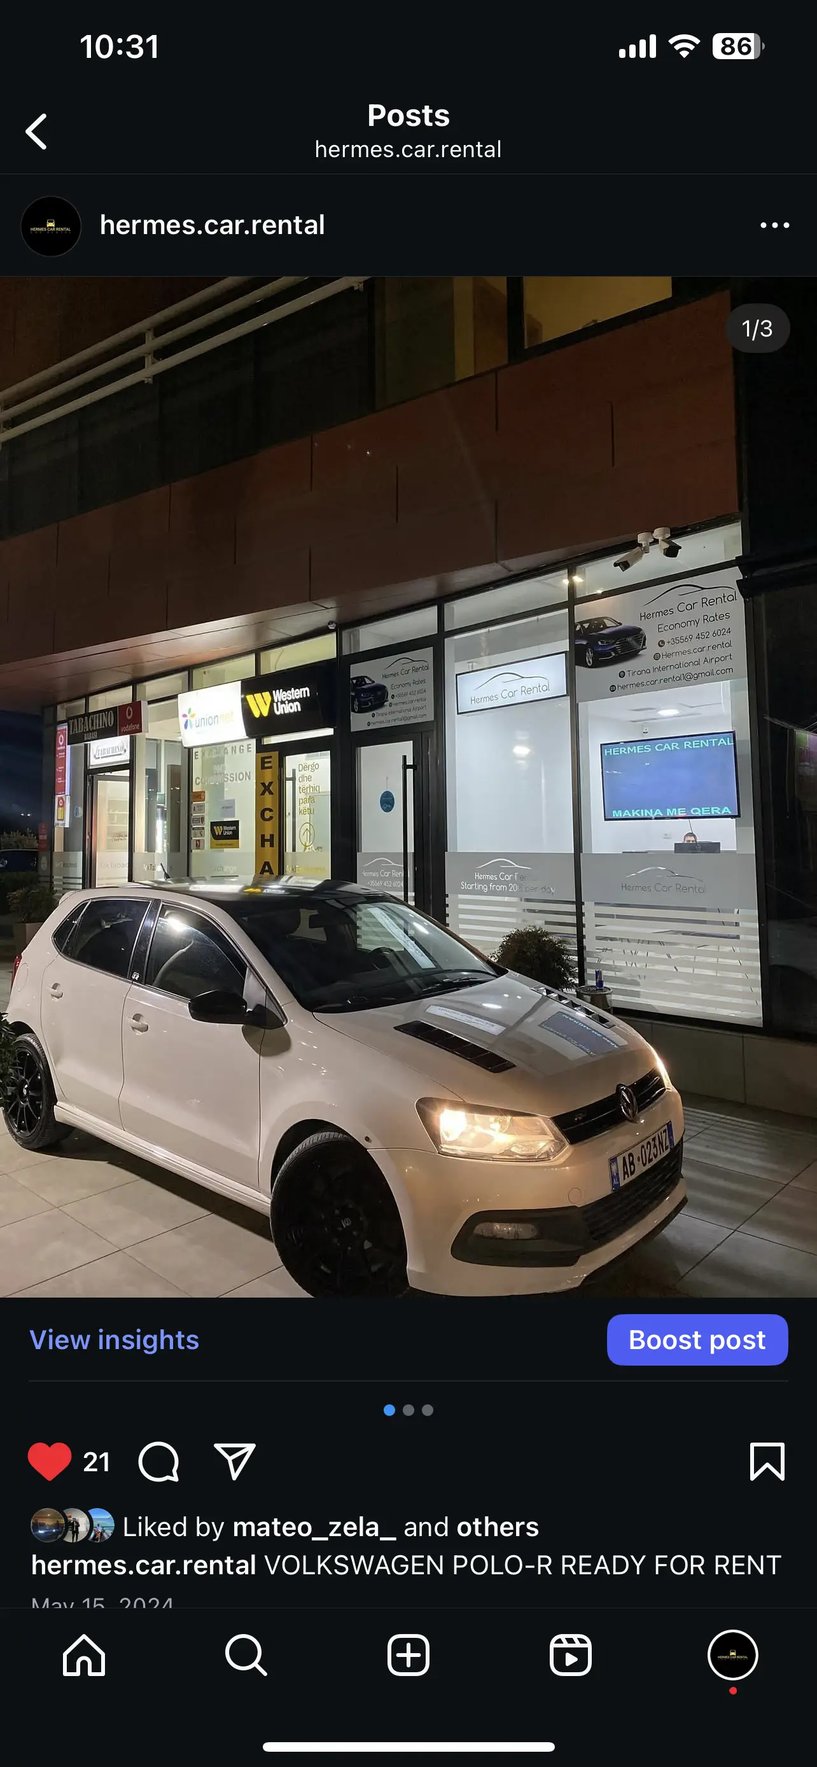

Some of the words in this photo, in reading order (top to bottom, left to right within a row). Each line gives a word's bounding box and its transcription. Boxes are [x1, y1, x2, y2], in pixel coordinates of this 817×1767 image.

[640, 608, 674, 622] Hermes
[676, 601, 698, 613] Car
[701, 591, 738, 607] Rental
[658, 617, 700, 633] Economy
[702, 612, 730, 624] Rates
[666, 634, 694, 646] +35569
[696, 631, 710, 641] 452
[712, 628, 731, 638] 6024
[661, 640, 732, 660] Hermes.car.rental
[412, 664, 429, 673] Rental
[628, 668, 651, 678] Tirana
[652, 658, 700, 673] International
[702, 653, 733, 666] Airport
[272, 686, 310, 702] Western
[470, 693, 498, 705] Hermes
[500, 688, 518, 700] Car
[520, 681, 550, 696] Rental
[274, 700, 301, 716] Union
[604, 744, 652, 756] HERMES
[654, 742, 680, 752] CAR
[684, 737, 734, 750] RENTAL
[612, 808, 663, 818] MAKINA
[666, 808, 686, 816] ME
[690, 806, 732, 816] QERA
[474, 872, 498, 880] Hermes
[499, 872, 514, 881] Car
[460, 881, 488, 892] Starting
[489, 882, 507, 891] from
[620, 882, 651, 892] Hermes
[654, 882, 672, 892] Car
